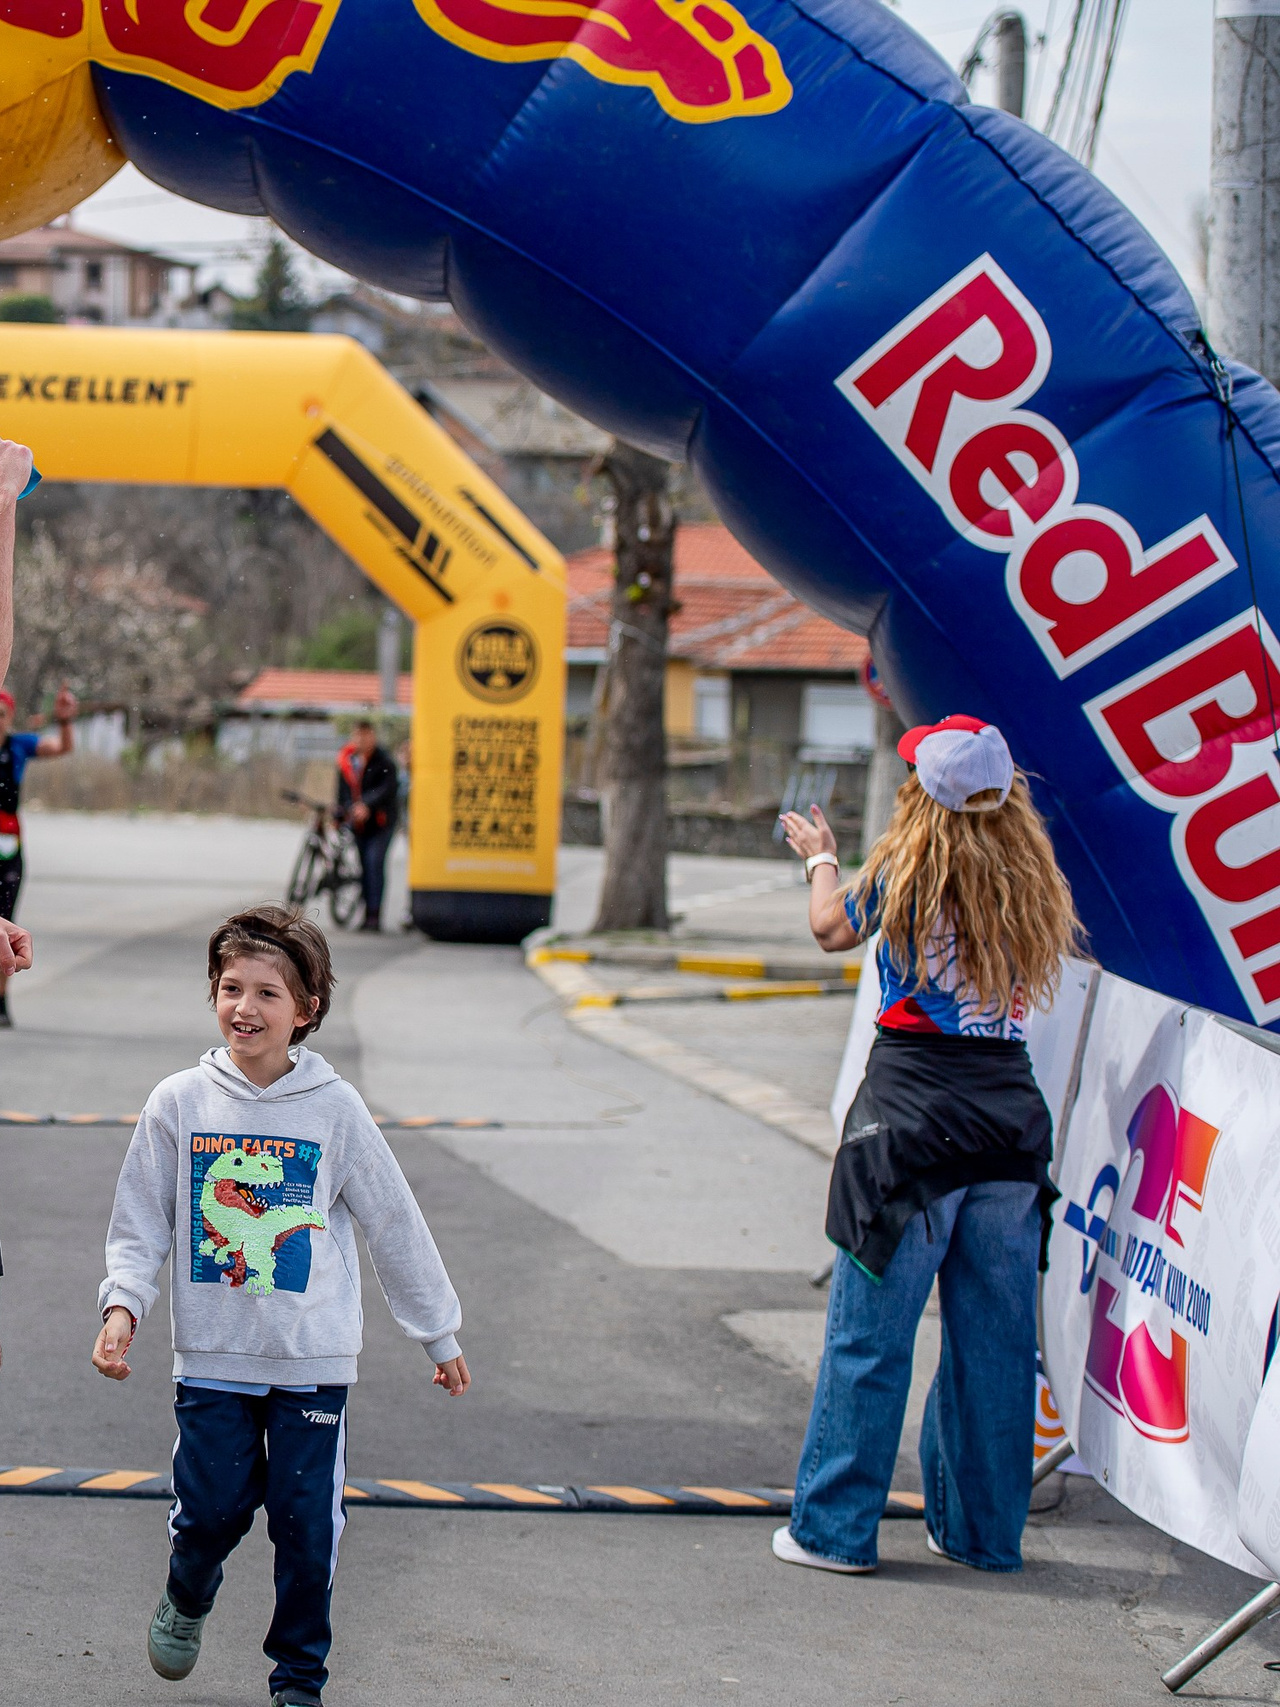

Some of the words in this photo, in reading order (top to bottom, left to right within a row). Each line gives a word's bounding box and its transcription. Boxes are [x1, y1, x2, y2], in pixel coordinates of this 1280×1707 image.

[850, 266, 1223, 663] Red
[1100, 620, 1280, 1003] Bu
[453, 748, 540, 774] BUILD
[192, 1135, 236, 1154] DINO
[242, 1138, 297, 1158] FACTS
[193, 1155, 205, 1178] REX
[1185, 1279, 1211, 1337] 2000
